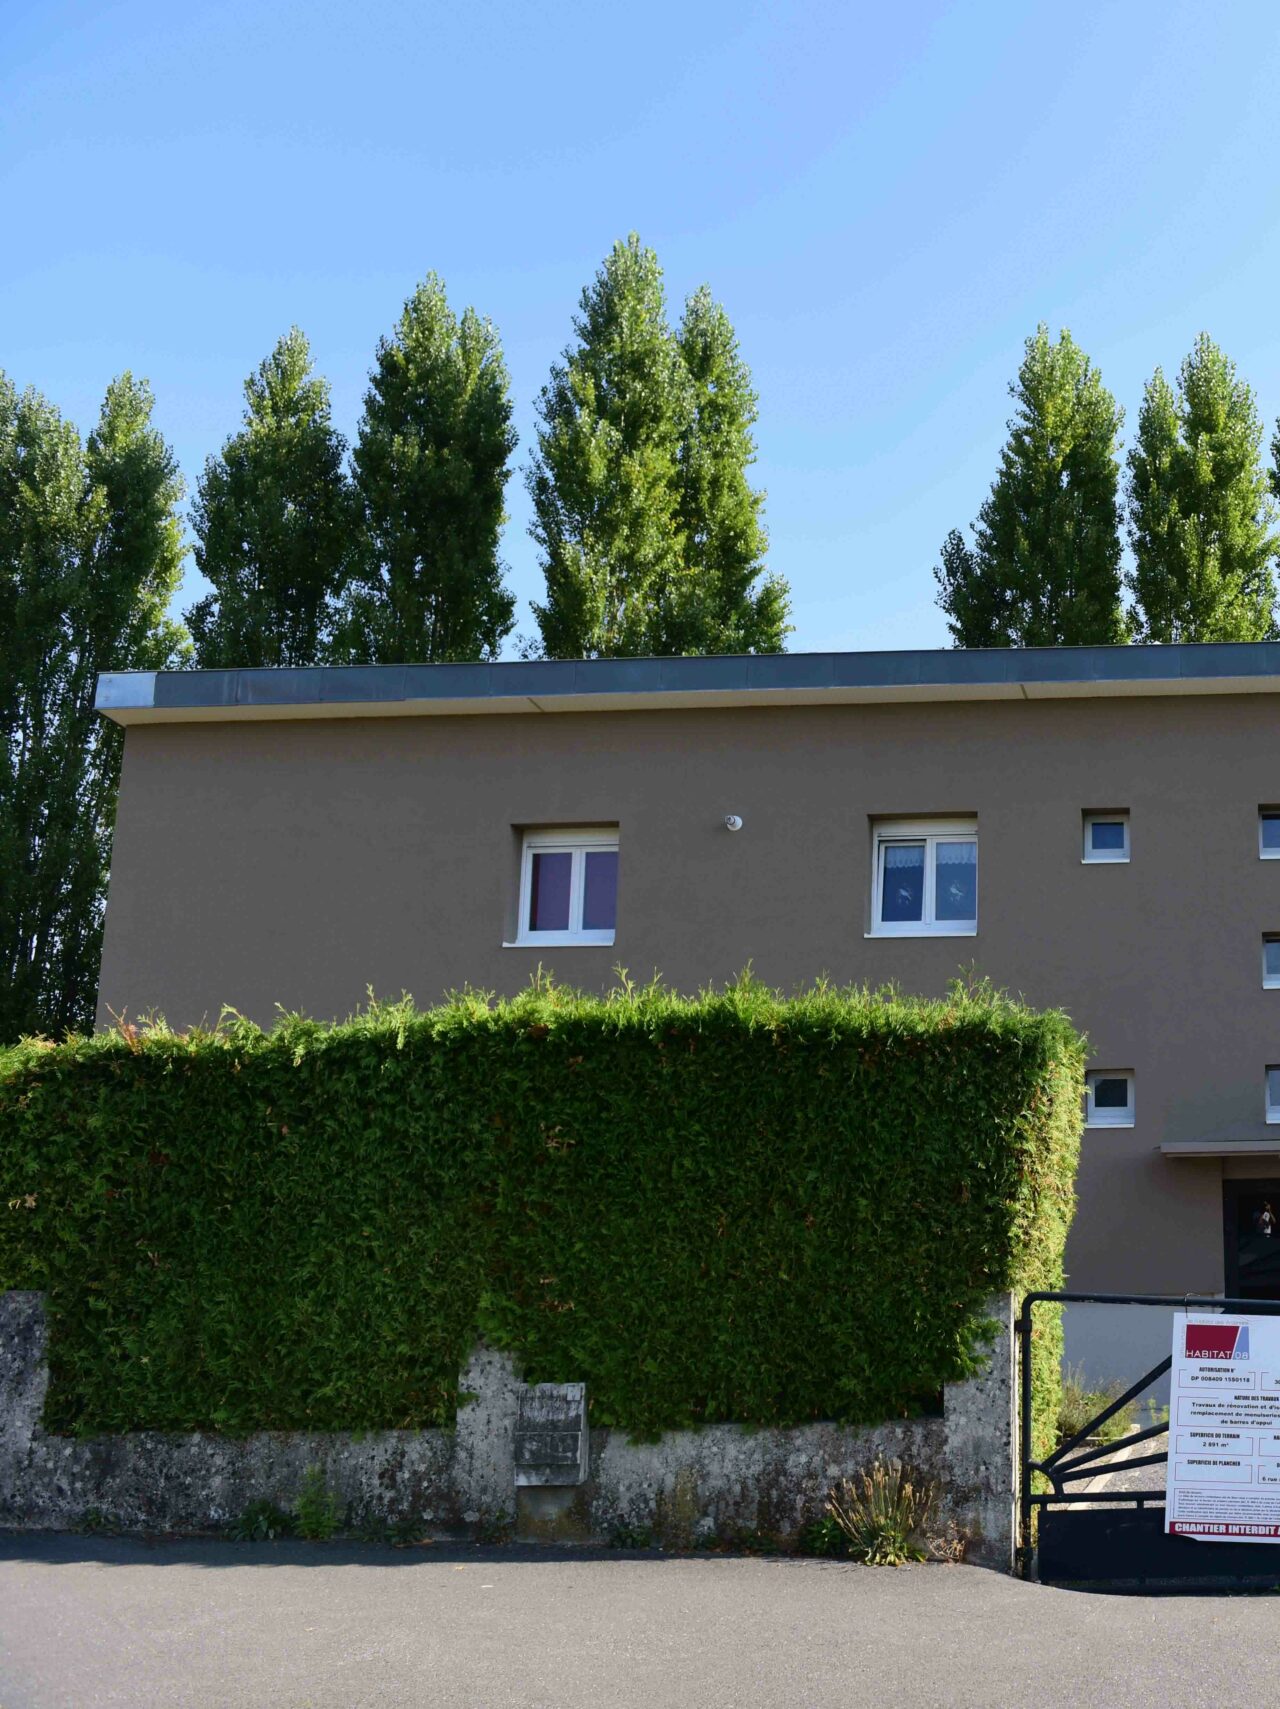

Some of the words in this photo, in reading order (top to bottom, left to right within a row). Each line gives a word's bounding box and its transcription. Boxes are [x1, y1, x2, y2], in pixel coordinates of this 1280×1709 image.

[1186, 1350, 1231, 1359] HABITAT
[1175, 1523, 1226, 1533] CHANTIER
[1228, 1525, 1276, 1535] INTERDIT
